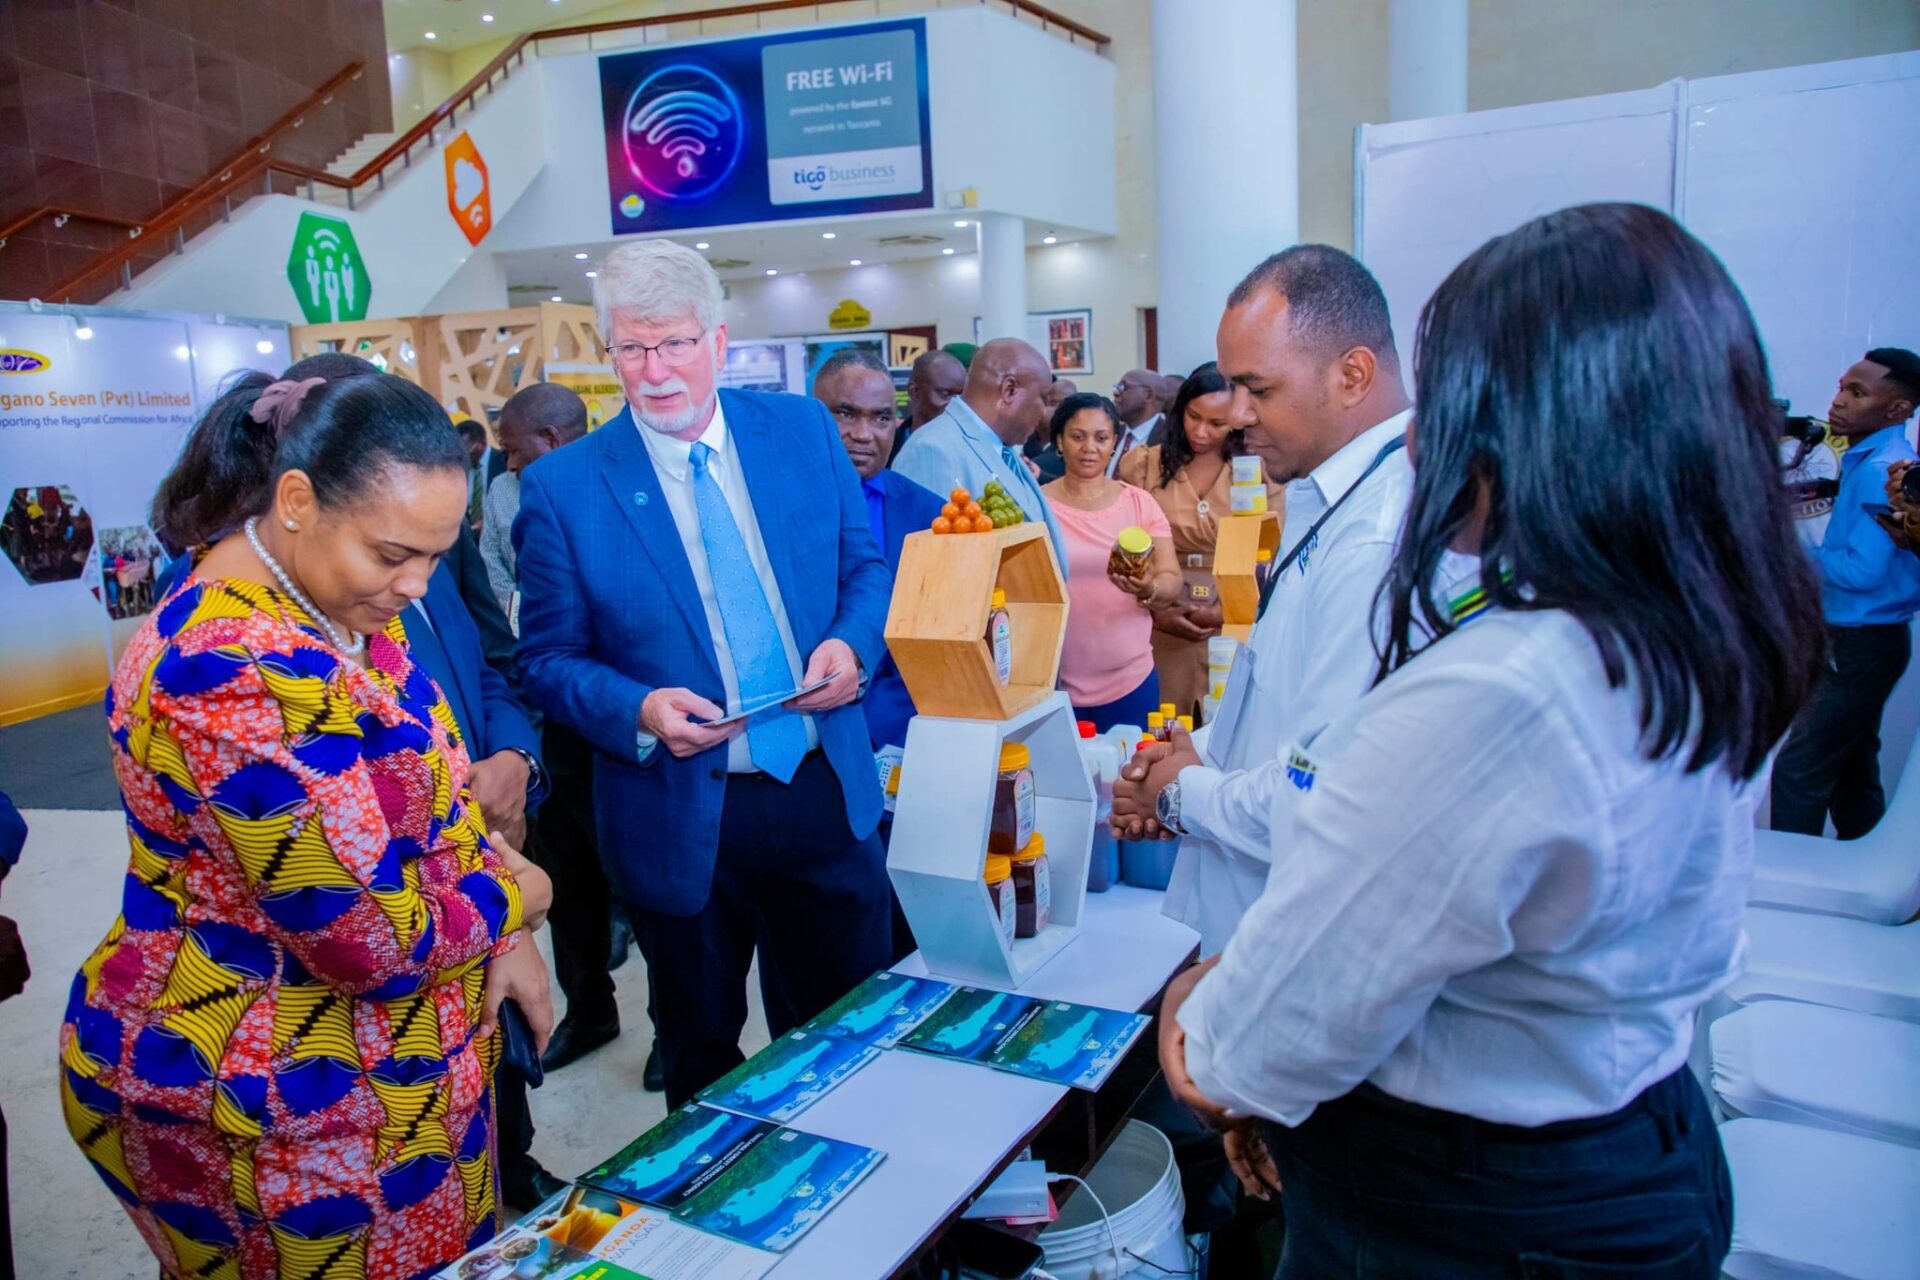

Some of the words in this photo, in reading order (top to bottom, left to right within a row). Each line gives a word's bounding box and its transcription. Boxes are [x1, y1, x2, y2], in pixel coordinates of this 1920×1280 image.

[786, 69, 834, 91] FREE
[839, 60, 893, 86] Wi-Fi
[836, 101, 849, 111] the
[803, 122, 835, 134] network
[837, 122, 846, 131] in
[846, 119, 881, 130] Tanzania
[829, 164, 896, 182] business
[48, 391, 96, 407] Seven
[101, 391, 135, 408] (Pvt)
[138, 391, 191, 406] Limited
[42, 415, 60, 426] the
[103, 414, 156, 425] Commission
[156, 414, 168, 424] for
[170, 414, 193, 425] Africa
[722, 1150, 742, 1165] FOREST
[630, 1217, 666, 1249] ASALI
